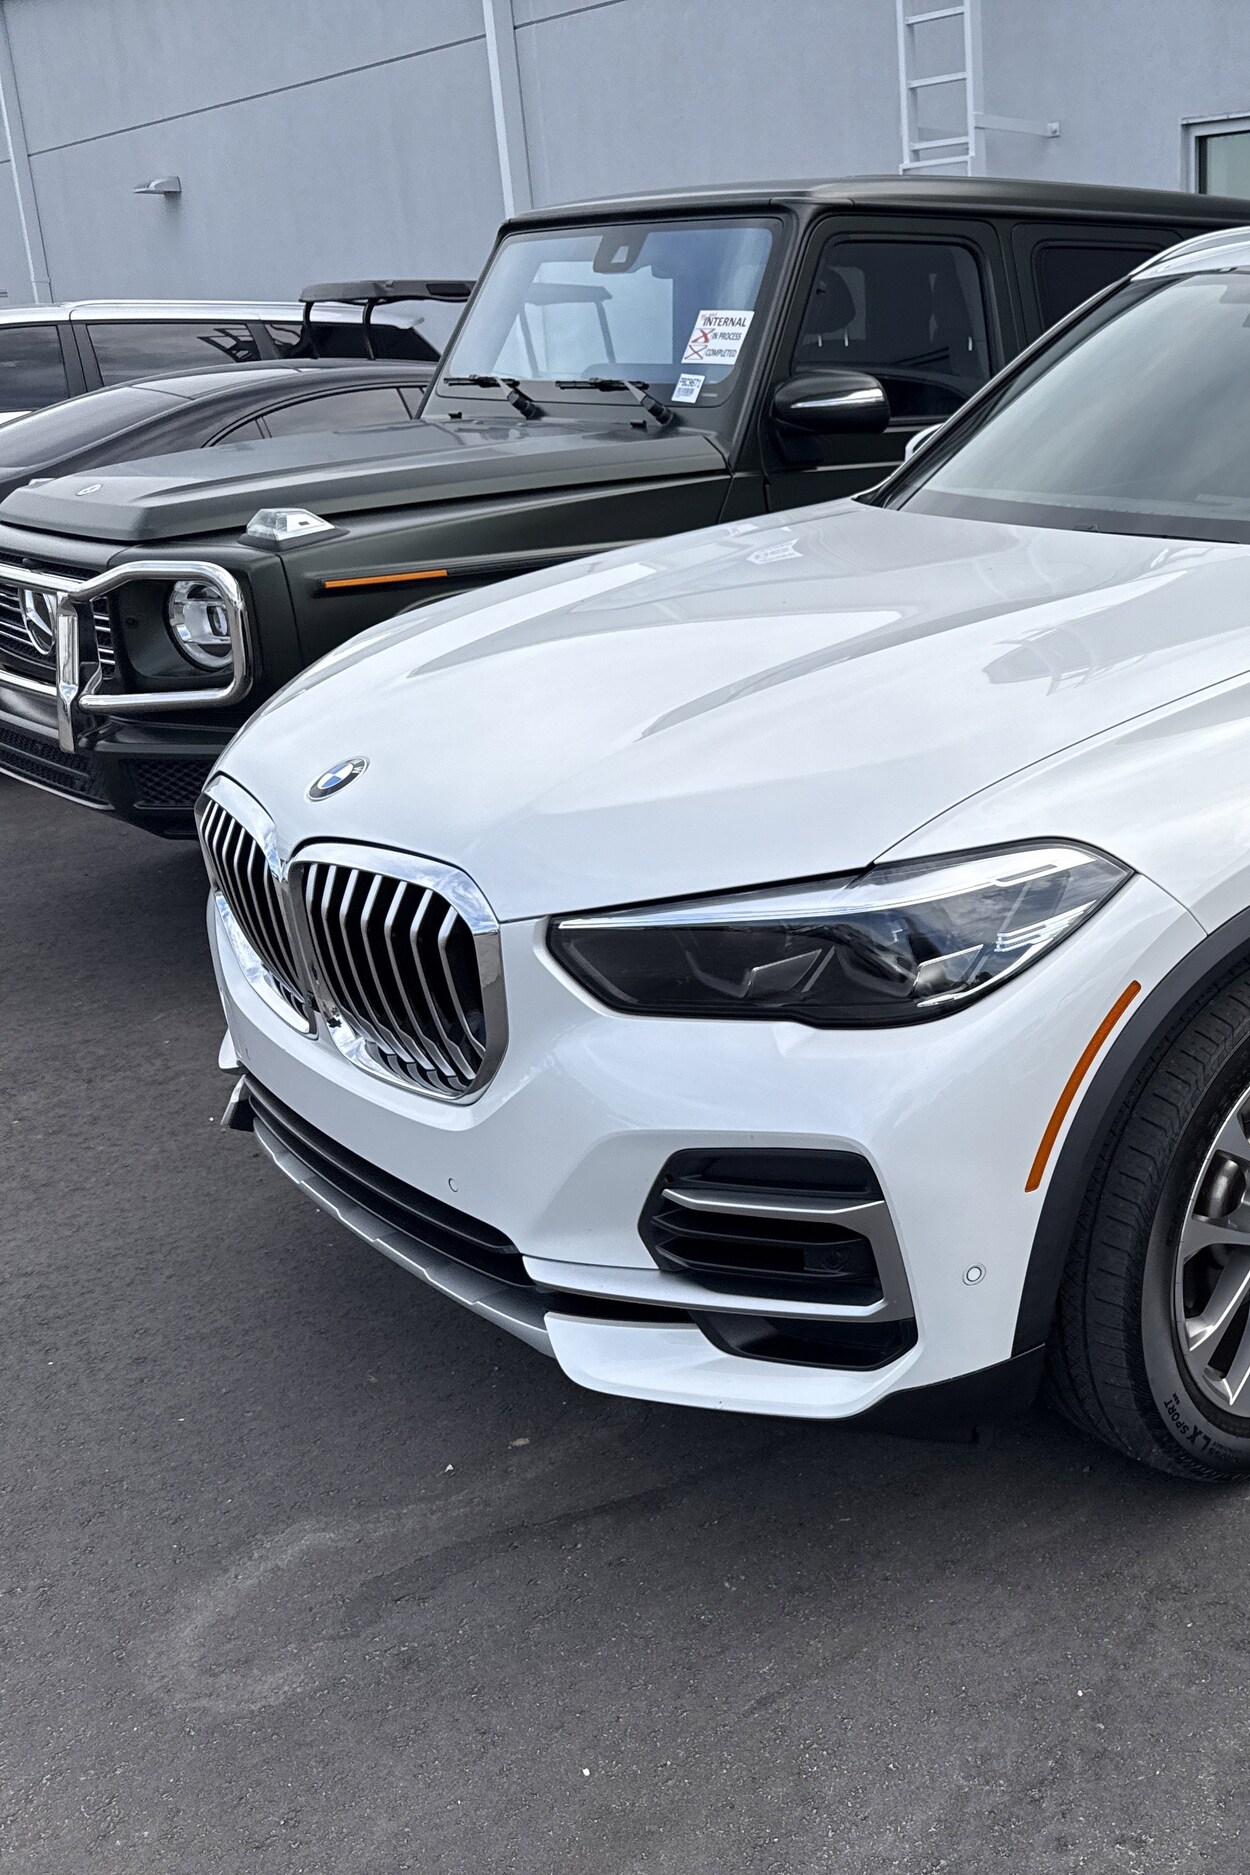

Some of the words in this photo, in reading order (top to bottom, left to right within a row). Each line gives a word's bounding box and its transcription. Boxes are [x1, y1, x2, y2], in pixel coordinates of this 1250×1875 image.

[703, 317, 746, 327] INTERNAL
[719, 332, 742, 341] PROCESS
[705, 348, 737, 357] COMPLETED
[1164, 1400, 1189, 1434] SPORT
